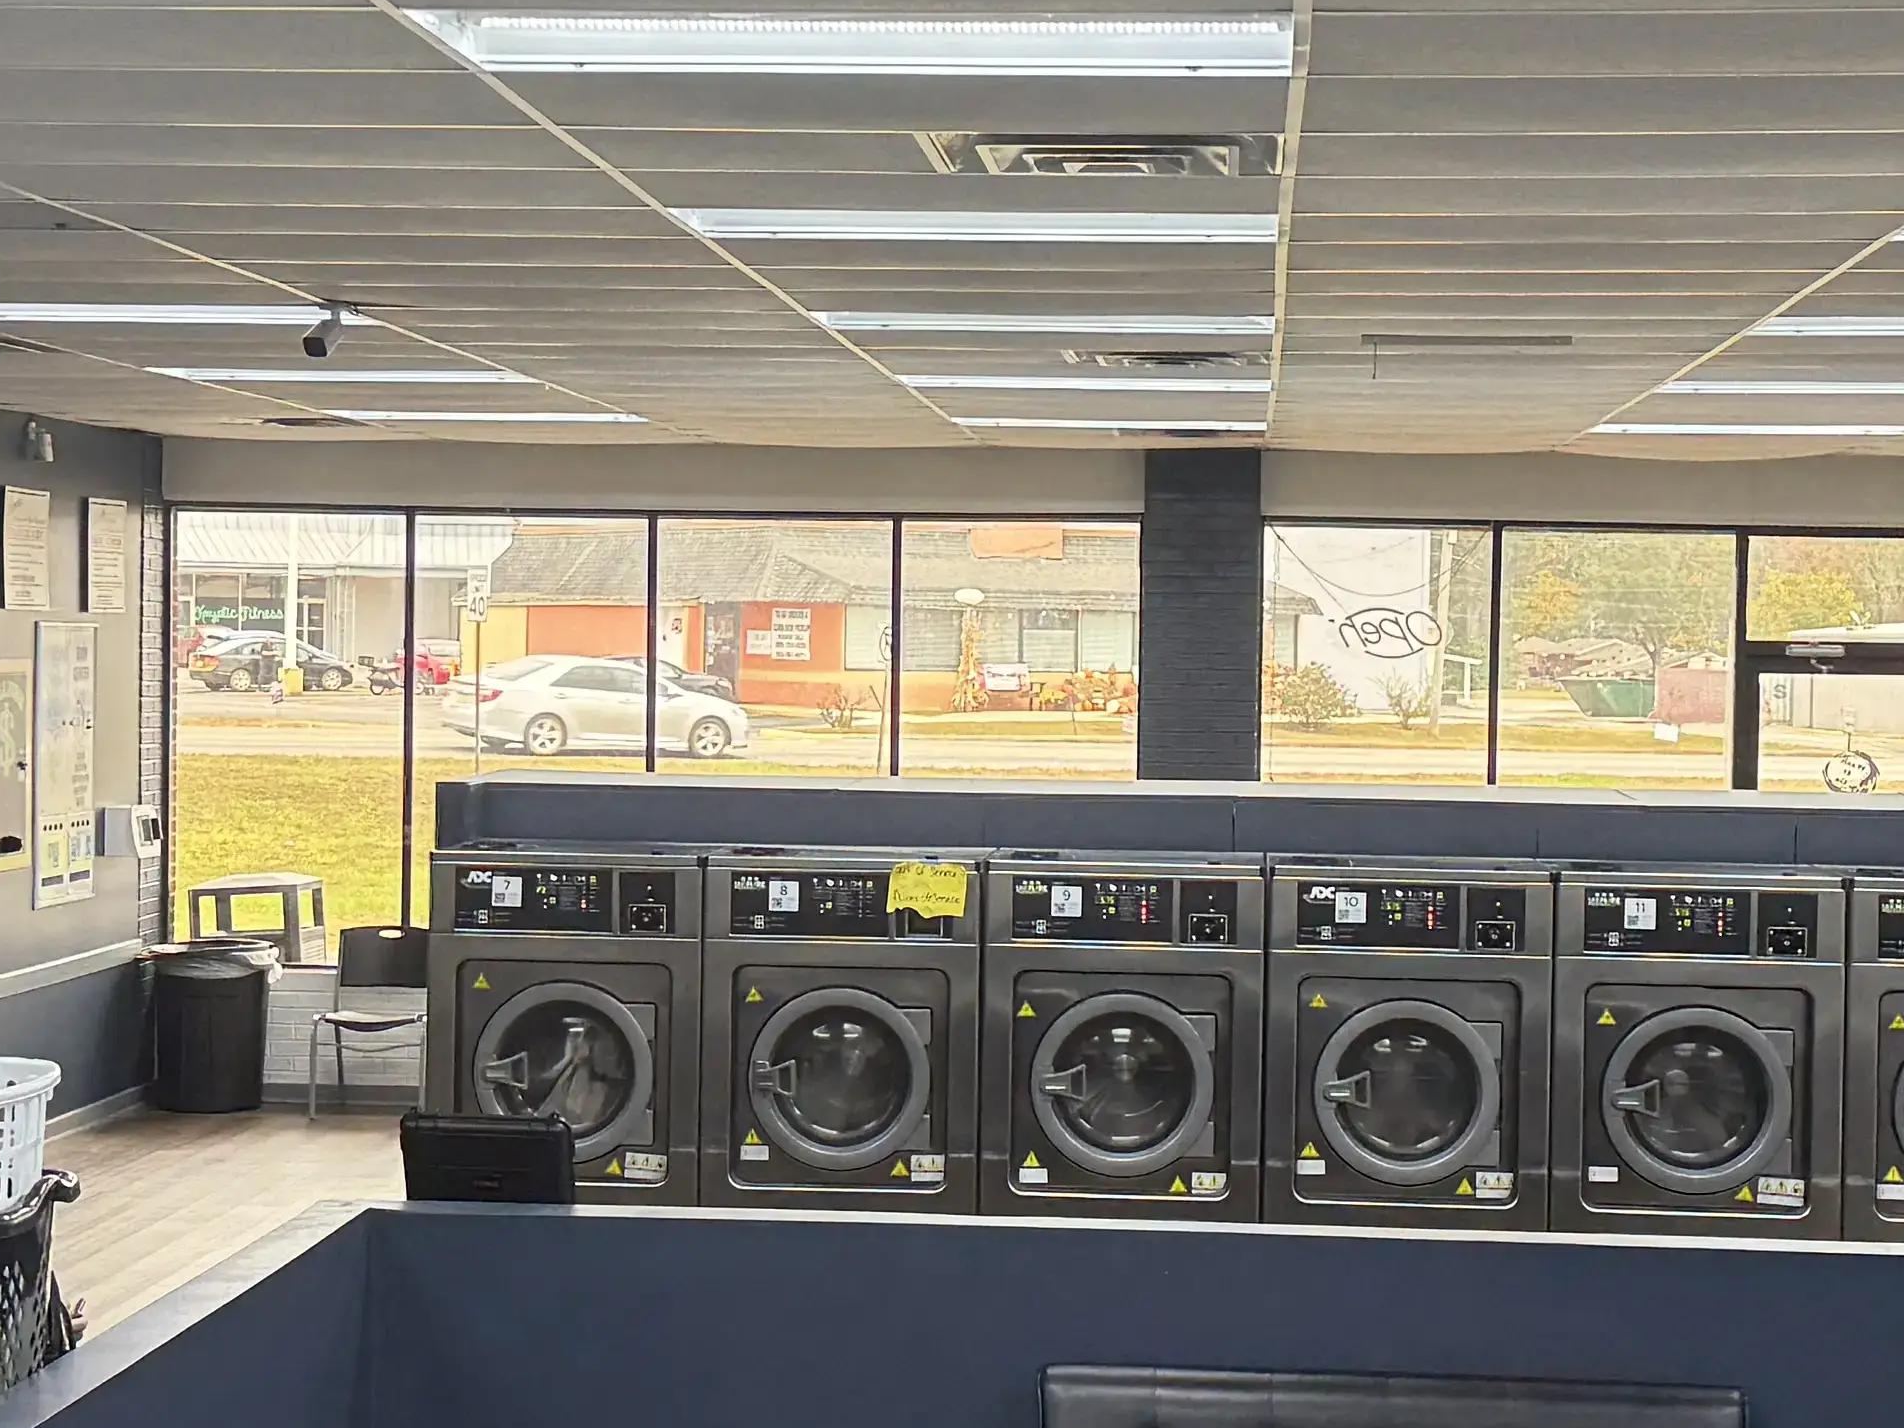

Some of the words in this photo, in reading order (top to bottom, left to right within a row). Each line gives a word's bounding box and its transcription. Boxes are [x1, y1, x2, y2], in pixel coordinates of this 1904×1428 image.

[470, 596, 484, 616] 40
[467, 870, 492, 884] ADC
[504, 880, 510, 890] 7
[780, 885, 788, 896] 8
[1062, 890, 1072, 902] 9
[1309, 886, 1336, 899] ADC
[1344, 896, 1358, 908] 10
[1635, 902, 1646, 914] 11
